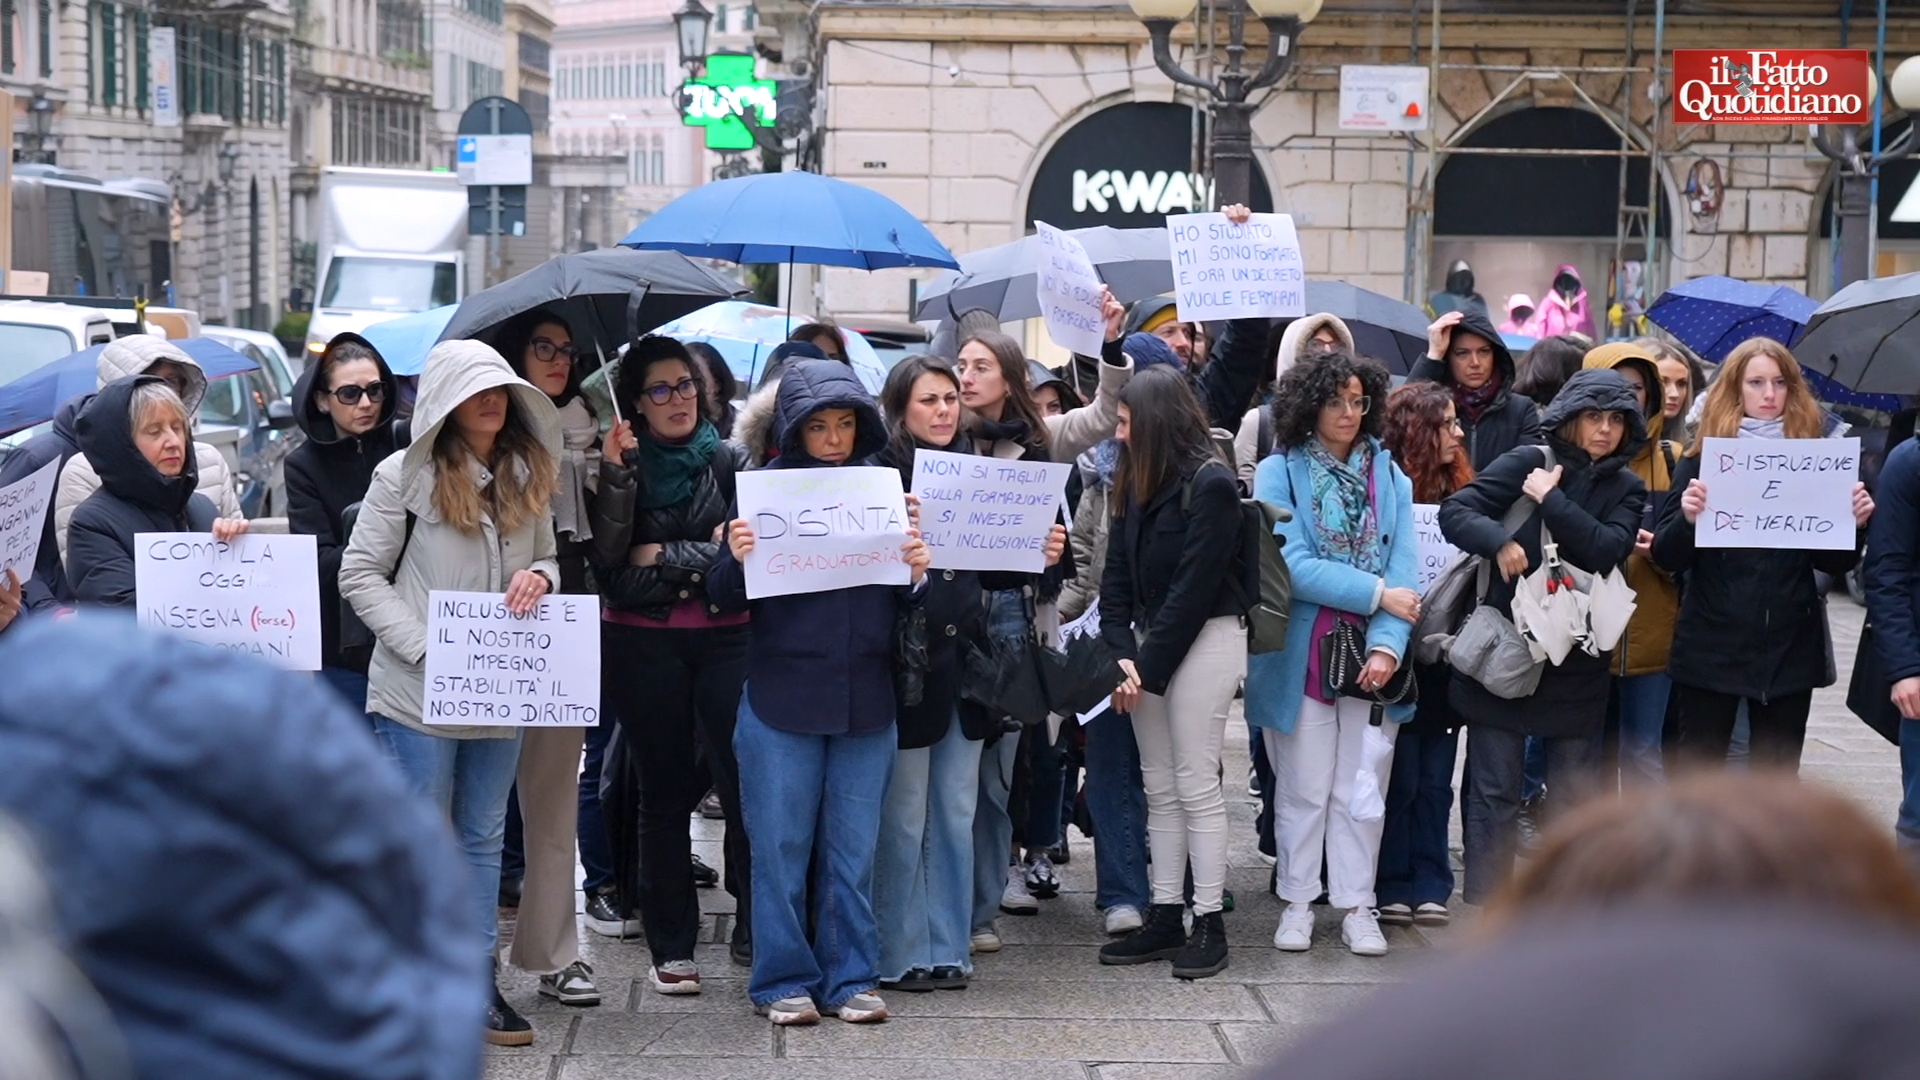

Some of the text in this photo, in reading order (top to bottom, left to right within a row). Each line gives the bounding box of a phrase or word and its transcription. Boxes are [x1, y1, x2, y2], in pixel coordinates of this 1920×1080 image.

[1174, 225, 1200, 243] HO
[1178, 248, 1197, 266] MI
[1209, 245, 1251, 261] SONO
[1180, 268, 1302, 285] E ORA UN DECRETO
[1183, 291, 1300, 308] VUOLE FERMARMI
[922, 460, 1047, 483] NON SI TAGLIA
[920, 487, 1053, 506] SULLA FORMAZIONE
[1762, 480, 1782, 500] E
[937, 510, 1024, 526] SI INVESTE
[6, 526, 30, 552] PER
[922, 530, 1042, 550] ELL' INCLUSIONE
[149, 540, 274, 564] COMPILA
[767, 547, 901, 575] GRADUATORIA
[148, 603, 295, 632] INSEGNA (forse)
[439, 628, 551, 649] IL NOSTRO
[551, 681, 568, 697] IL
[430, 700, 597, 723] NOSTRO DIRITTO
